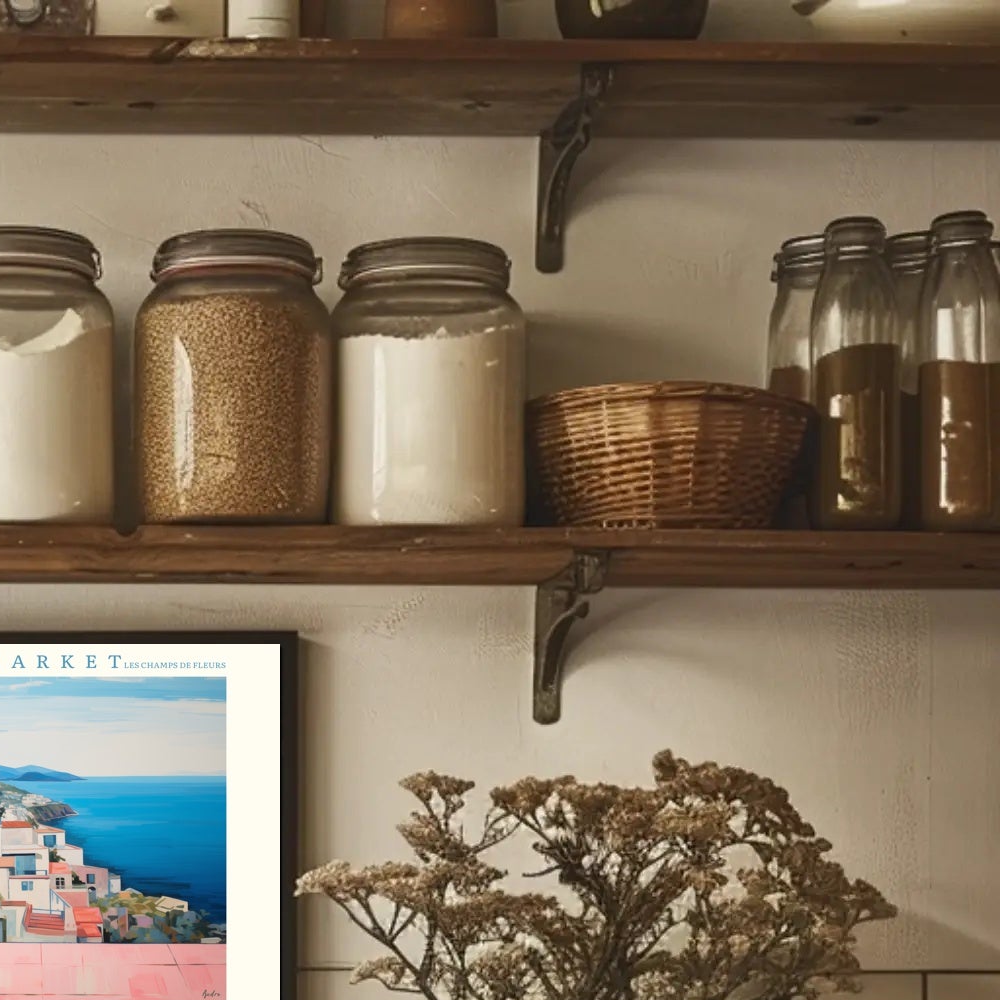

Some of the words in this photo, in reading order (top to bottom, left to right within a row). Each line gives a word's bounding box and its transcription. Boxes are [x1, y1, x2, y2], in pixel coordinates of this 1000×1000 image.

[123, 661, 140, 669] LES
[140, 661, 179, 669] CHAMPS
[179, 661, 192, 669] DE
[192, 661, 227, 669] FLEURS
